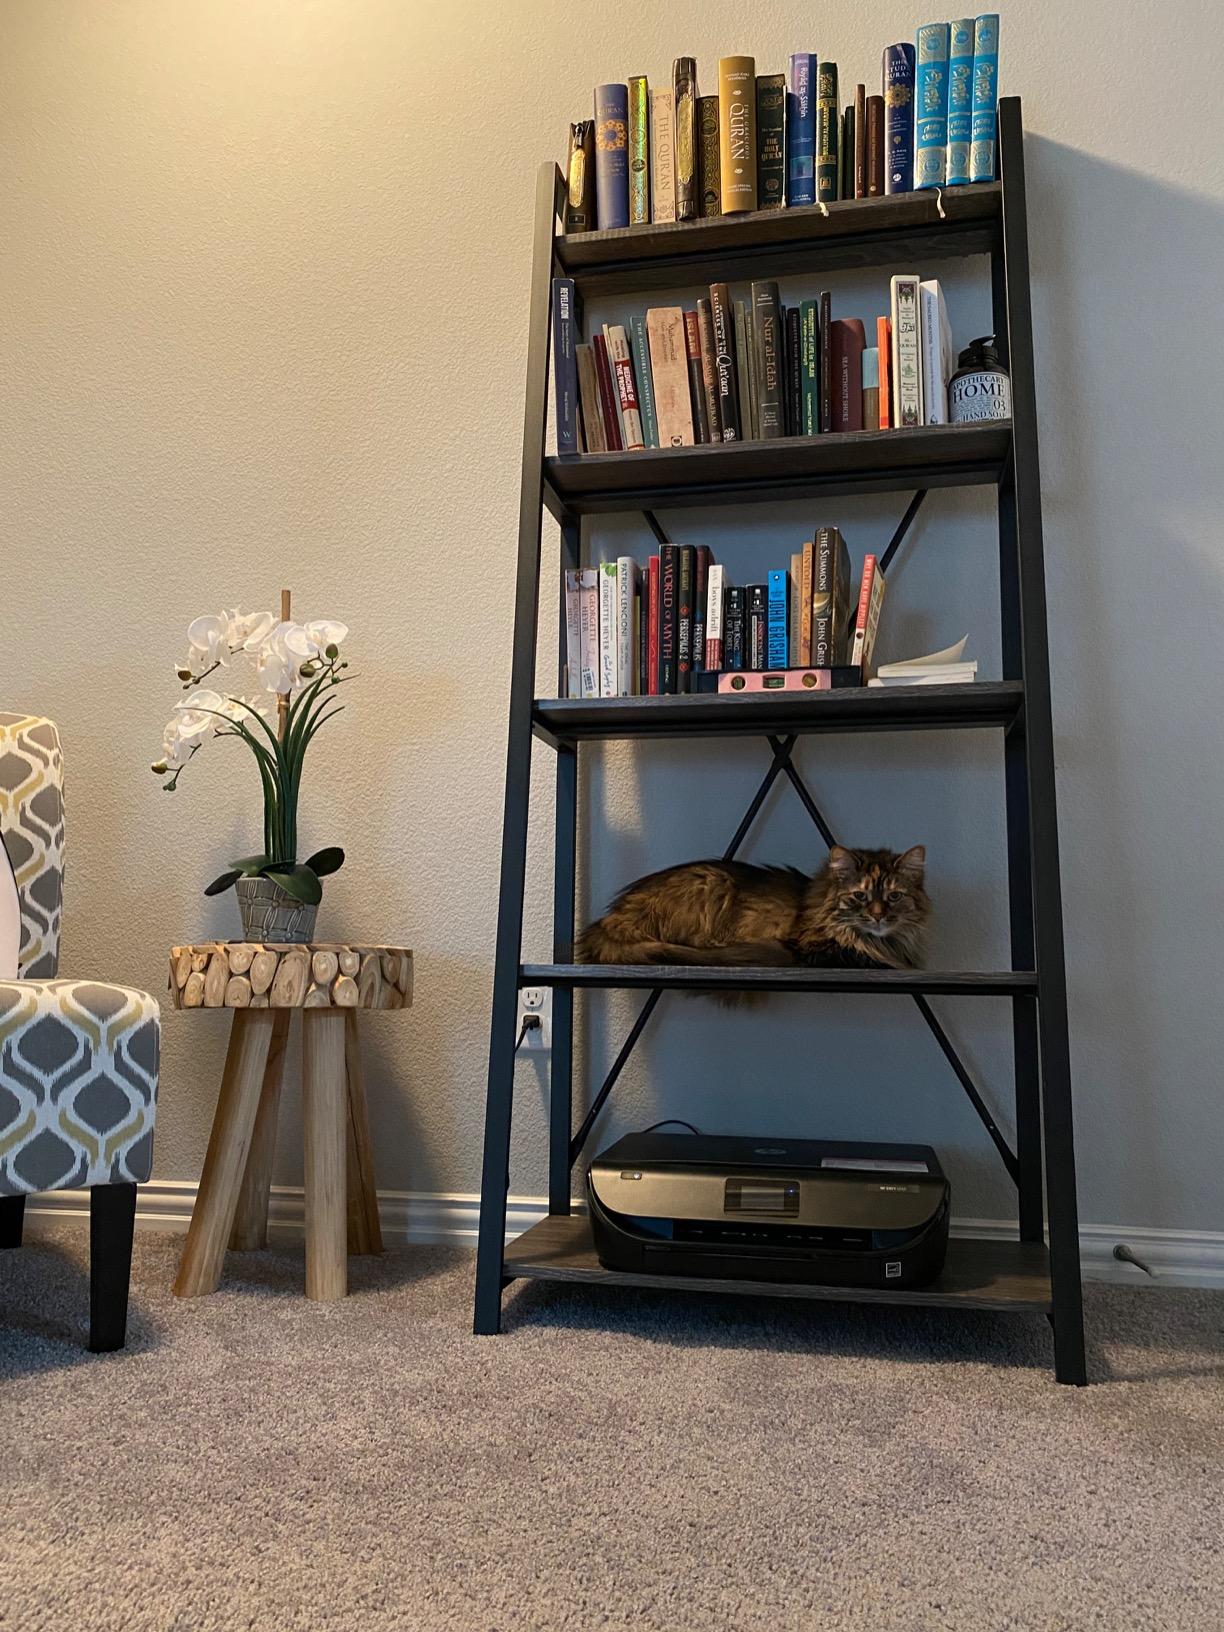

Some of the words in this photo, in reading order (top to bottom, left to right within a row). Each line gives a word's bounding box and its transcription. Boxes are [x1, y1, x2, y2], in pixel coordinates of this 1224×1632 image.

[659, 115, 668, 140] THE
[729, 102, 745, 160] QURAN
[560, 287, 569, 320] REVELATION
[714, 292, 722, 327] SCIENCES
[668, 323, 678, 361] Muhammad
[687, 318, 695, 354] ISLAM
[764, 316, 773, 341] Nur
[615, 363, 623, 376] THE
[623, 366, 634, 393] MEDICINE
[639, 338, 647, 374] ACCESSIBLE
[643, 375, 652, 417] CONSPECTUS
[716, 354, 732, 396] Qur'aan
[765, 344, 776, 392] al-Idah
[617, 375, 627, 402] PROPHET
[953, 375, 1004, 390] APOTHECARY
[953, 383, 1005, 404] HOME
[627, 393, 635, 402] OF
[963, 411, 987, 422] HAND
[820, 532, 828, 548] THE
[819, 550, 830, 591] SUMMONS
[664, 563, 673, 608] WORLD
[711, 586, 720, 607] boys
[588, 594, 596, 641] GEORGETTE
[620, 602, 628, 637] LENCIONI
[665, 610, 671, 620] OF
[711, 608, 720, 633] adrift
[727, 620, 733, 628] OF
[768, 600, 785, 622] JOHN
[663, 623, 672, 659] MYTH
[679, 618, 689, 654] PERSEPOLIS
[694, 623, 703, 661] PERSEPOLIS
[816, 618, 828, 640] JOHN
